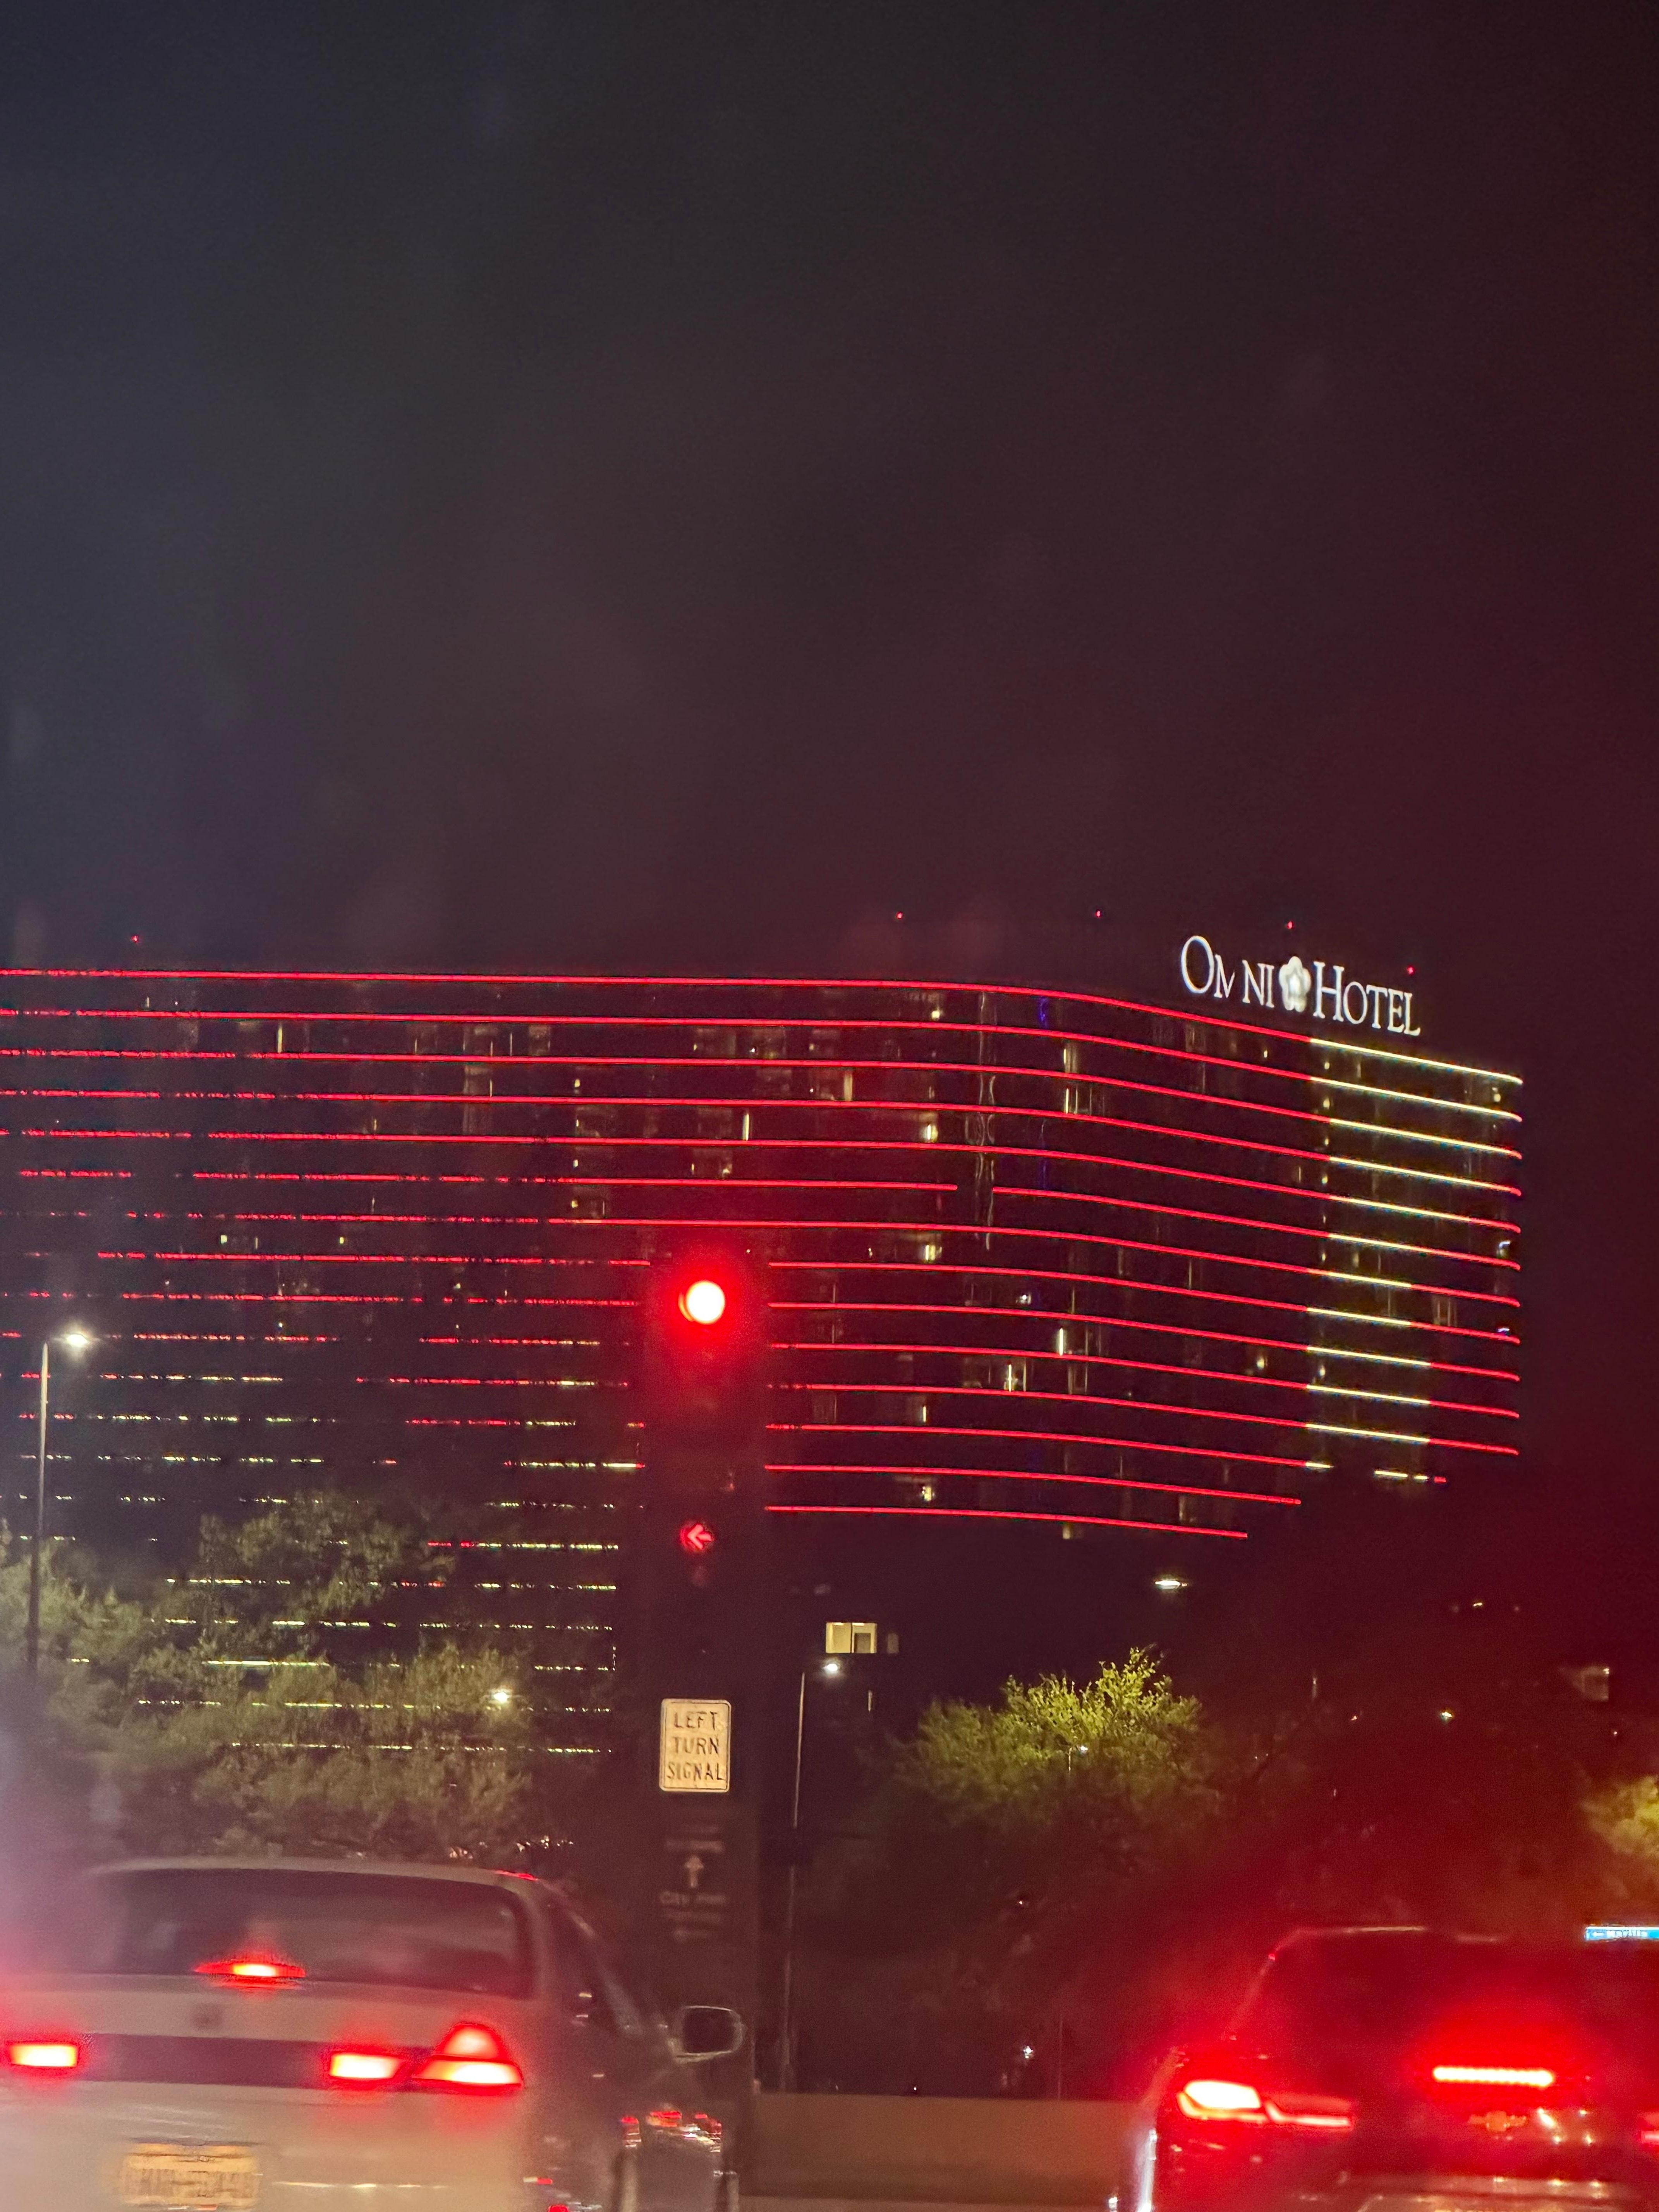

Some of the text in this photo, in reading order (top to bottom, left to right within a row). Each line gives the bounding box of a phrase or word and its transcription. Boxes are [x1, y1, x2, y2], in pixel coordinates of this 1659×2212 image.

[1313, 961, 1421, 1036] HOTEL
[674, 1711, 718, 1731] LEFT
[672, 1736, 719, 1755] TURN
[666, 1761, 725, 1781] SIGNAL
